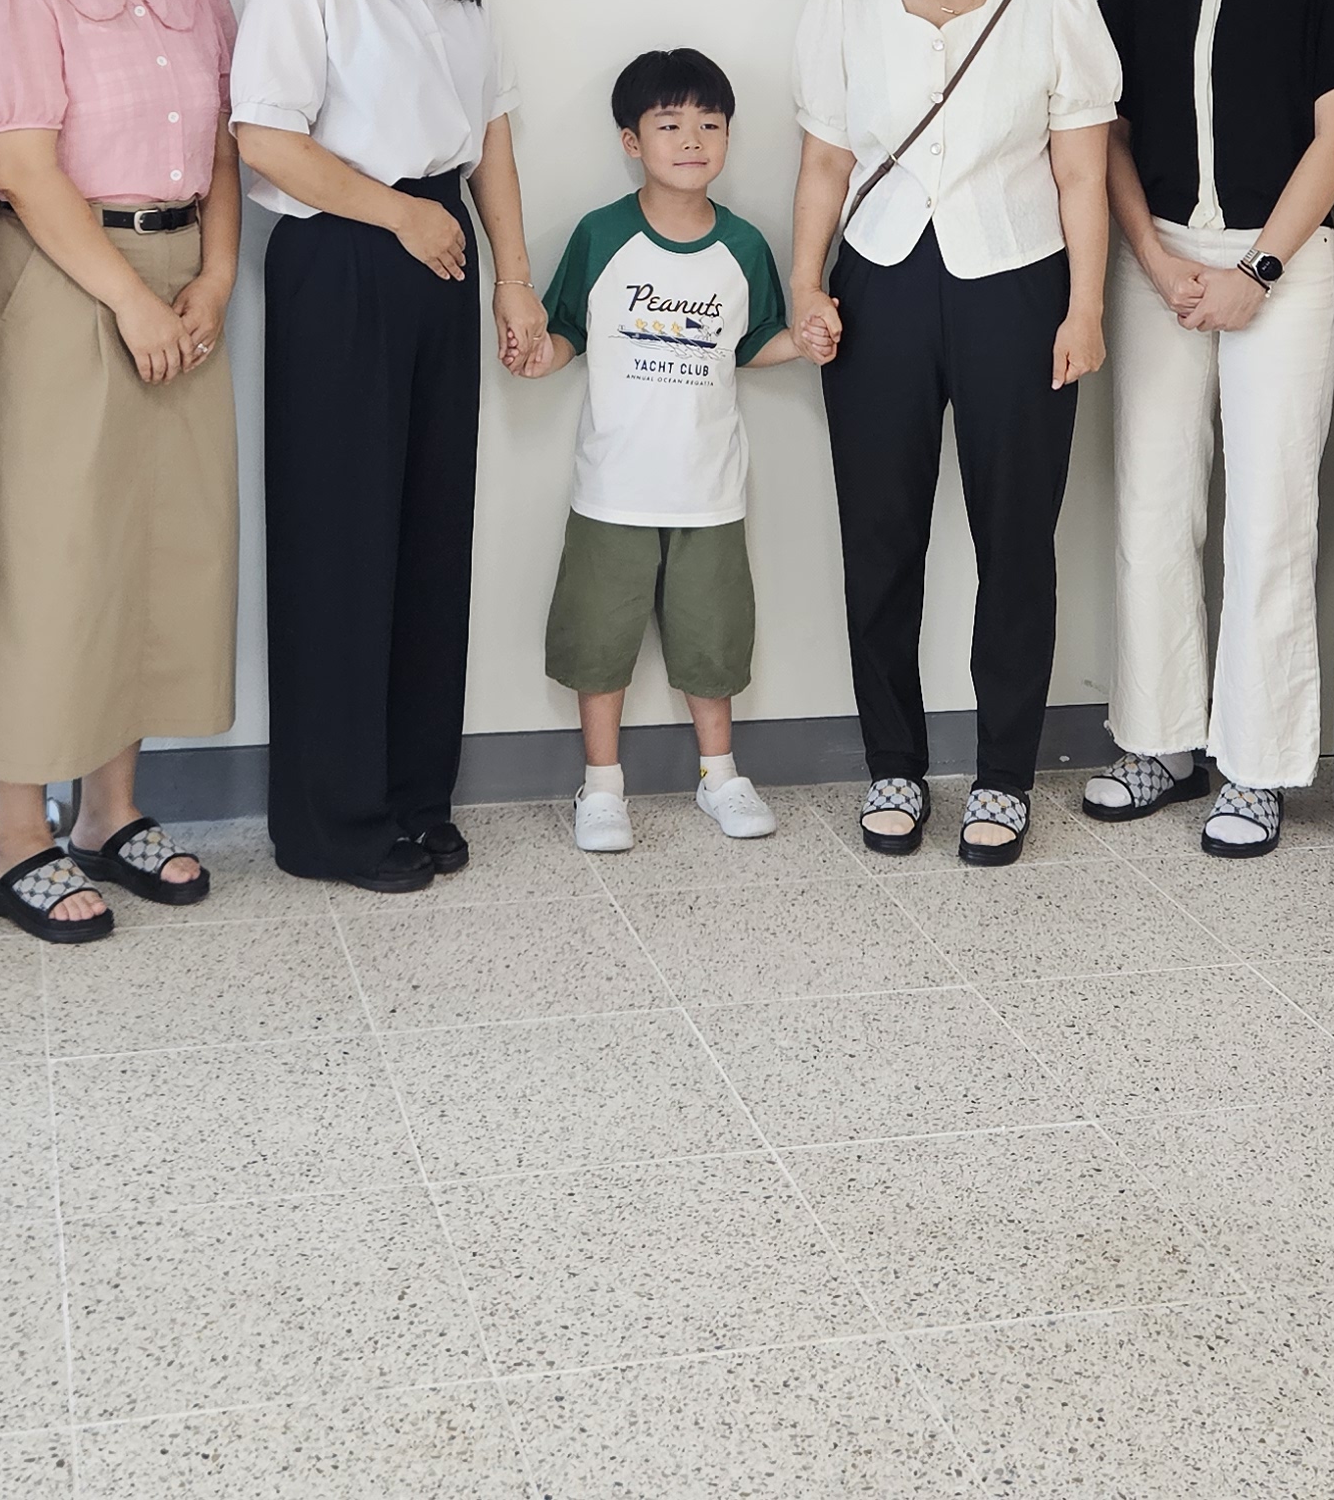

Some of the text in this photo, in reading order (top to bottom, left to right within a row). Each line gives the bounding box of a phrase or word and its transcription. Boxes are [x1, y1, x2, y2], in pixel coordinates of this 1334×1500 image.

[626, 283, 723, 317] Peanuts
[634, 358, 709, 377] YACHT CLUB
[657, 376, 683, 384] OCEAN
